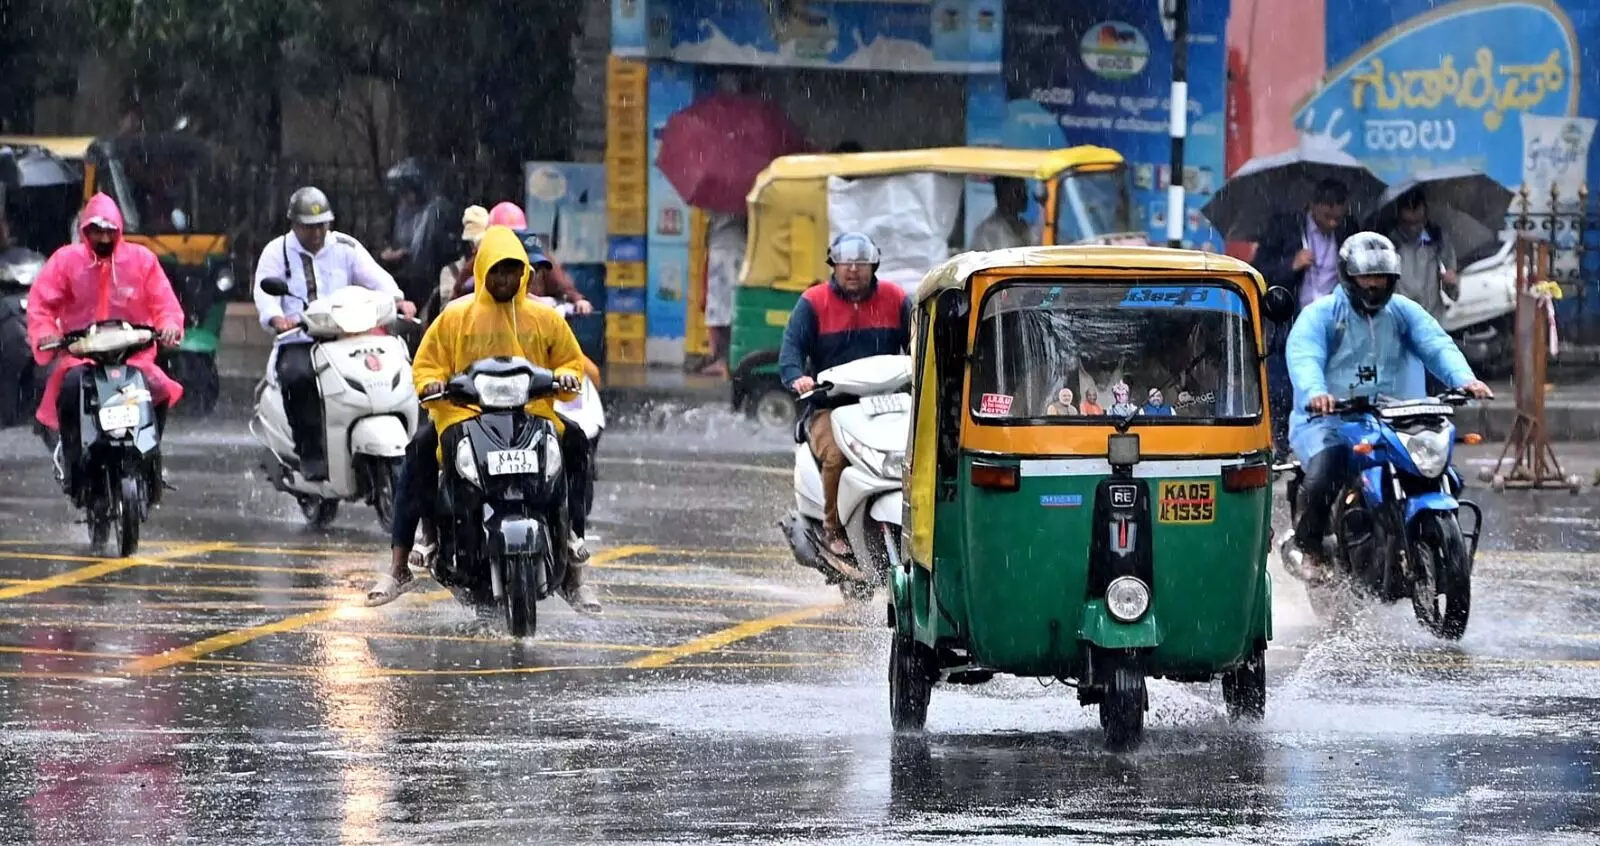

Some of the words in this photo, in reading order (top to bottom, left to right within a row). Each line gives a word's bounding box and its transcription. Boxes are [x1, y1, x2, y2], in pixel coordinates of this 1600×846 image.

[1364, 119, 1456, 150] ಹಾಲು
[498, 451, 527, 466] KA41
[1114, 492, 1132, 503] RE
[1165, 484, 1210, 500] KA05
